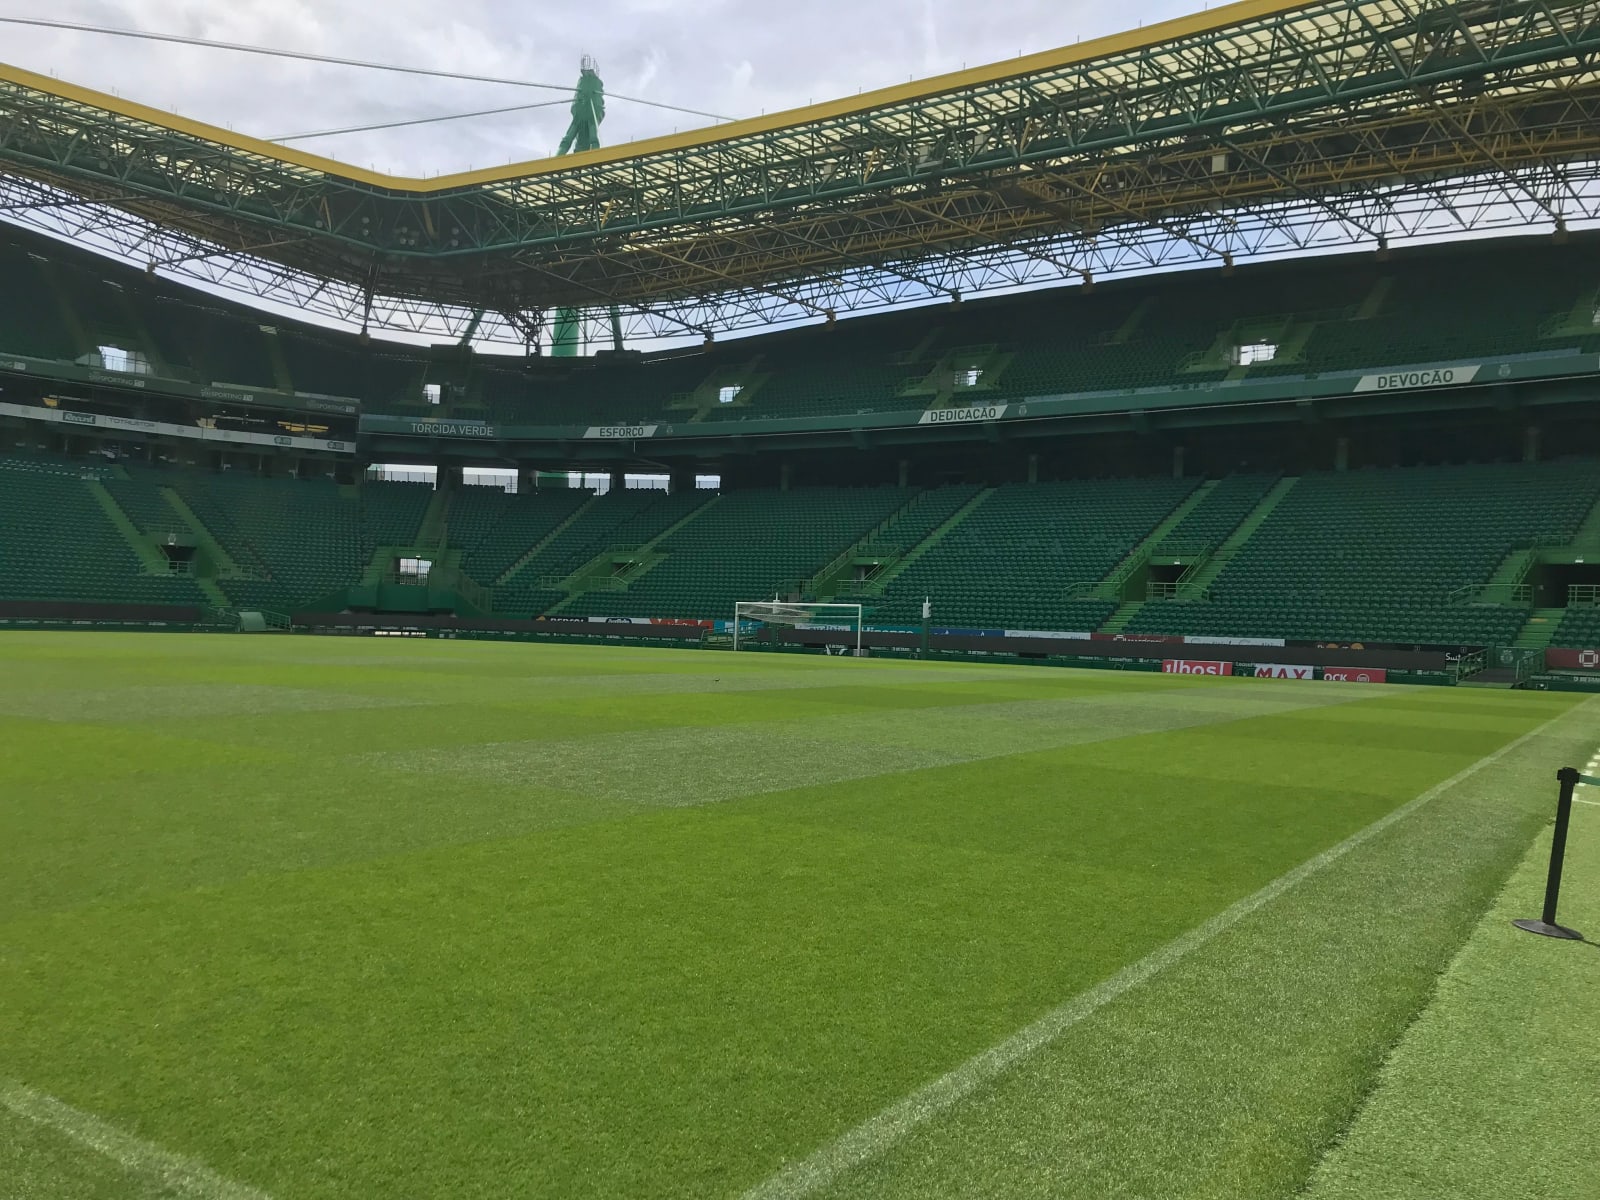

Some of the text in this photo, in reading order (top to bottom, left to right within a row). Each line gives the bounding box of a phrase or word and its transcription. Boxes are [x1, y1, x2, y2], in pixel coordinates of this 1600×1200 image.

[411, 423, 494, 437] TORCIDA VERDE
[1256, 667, 1307, 679] MAX
